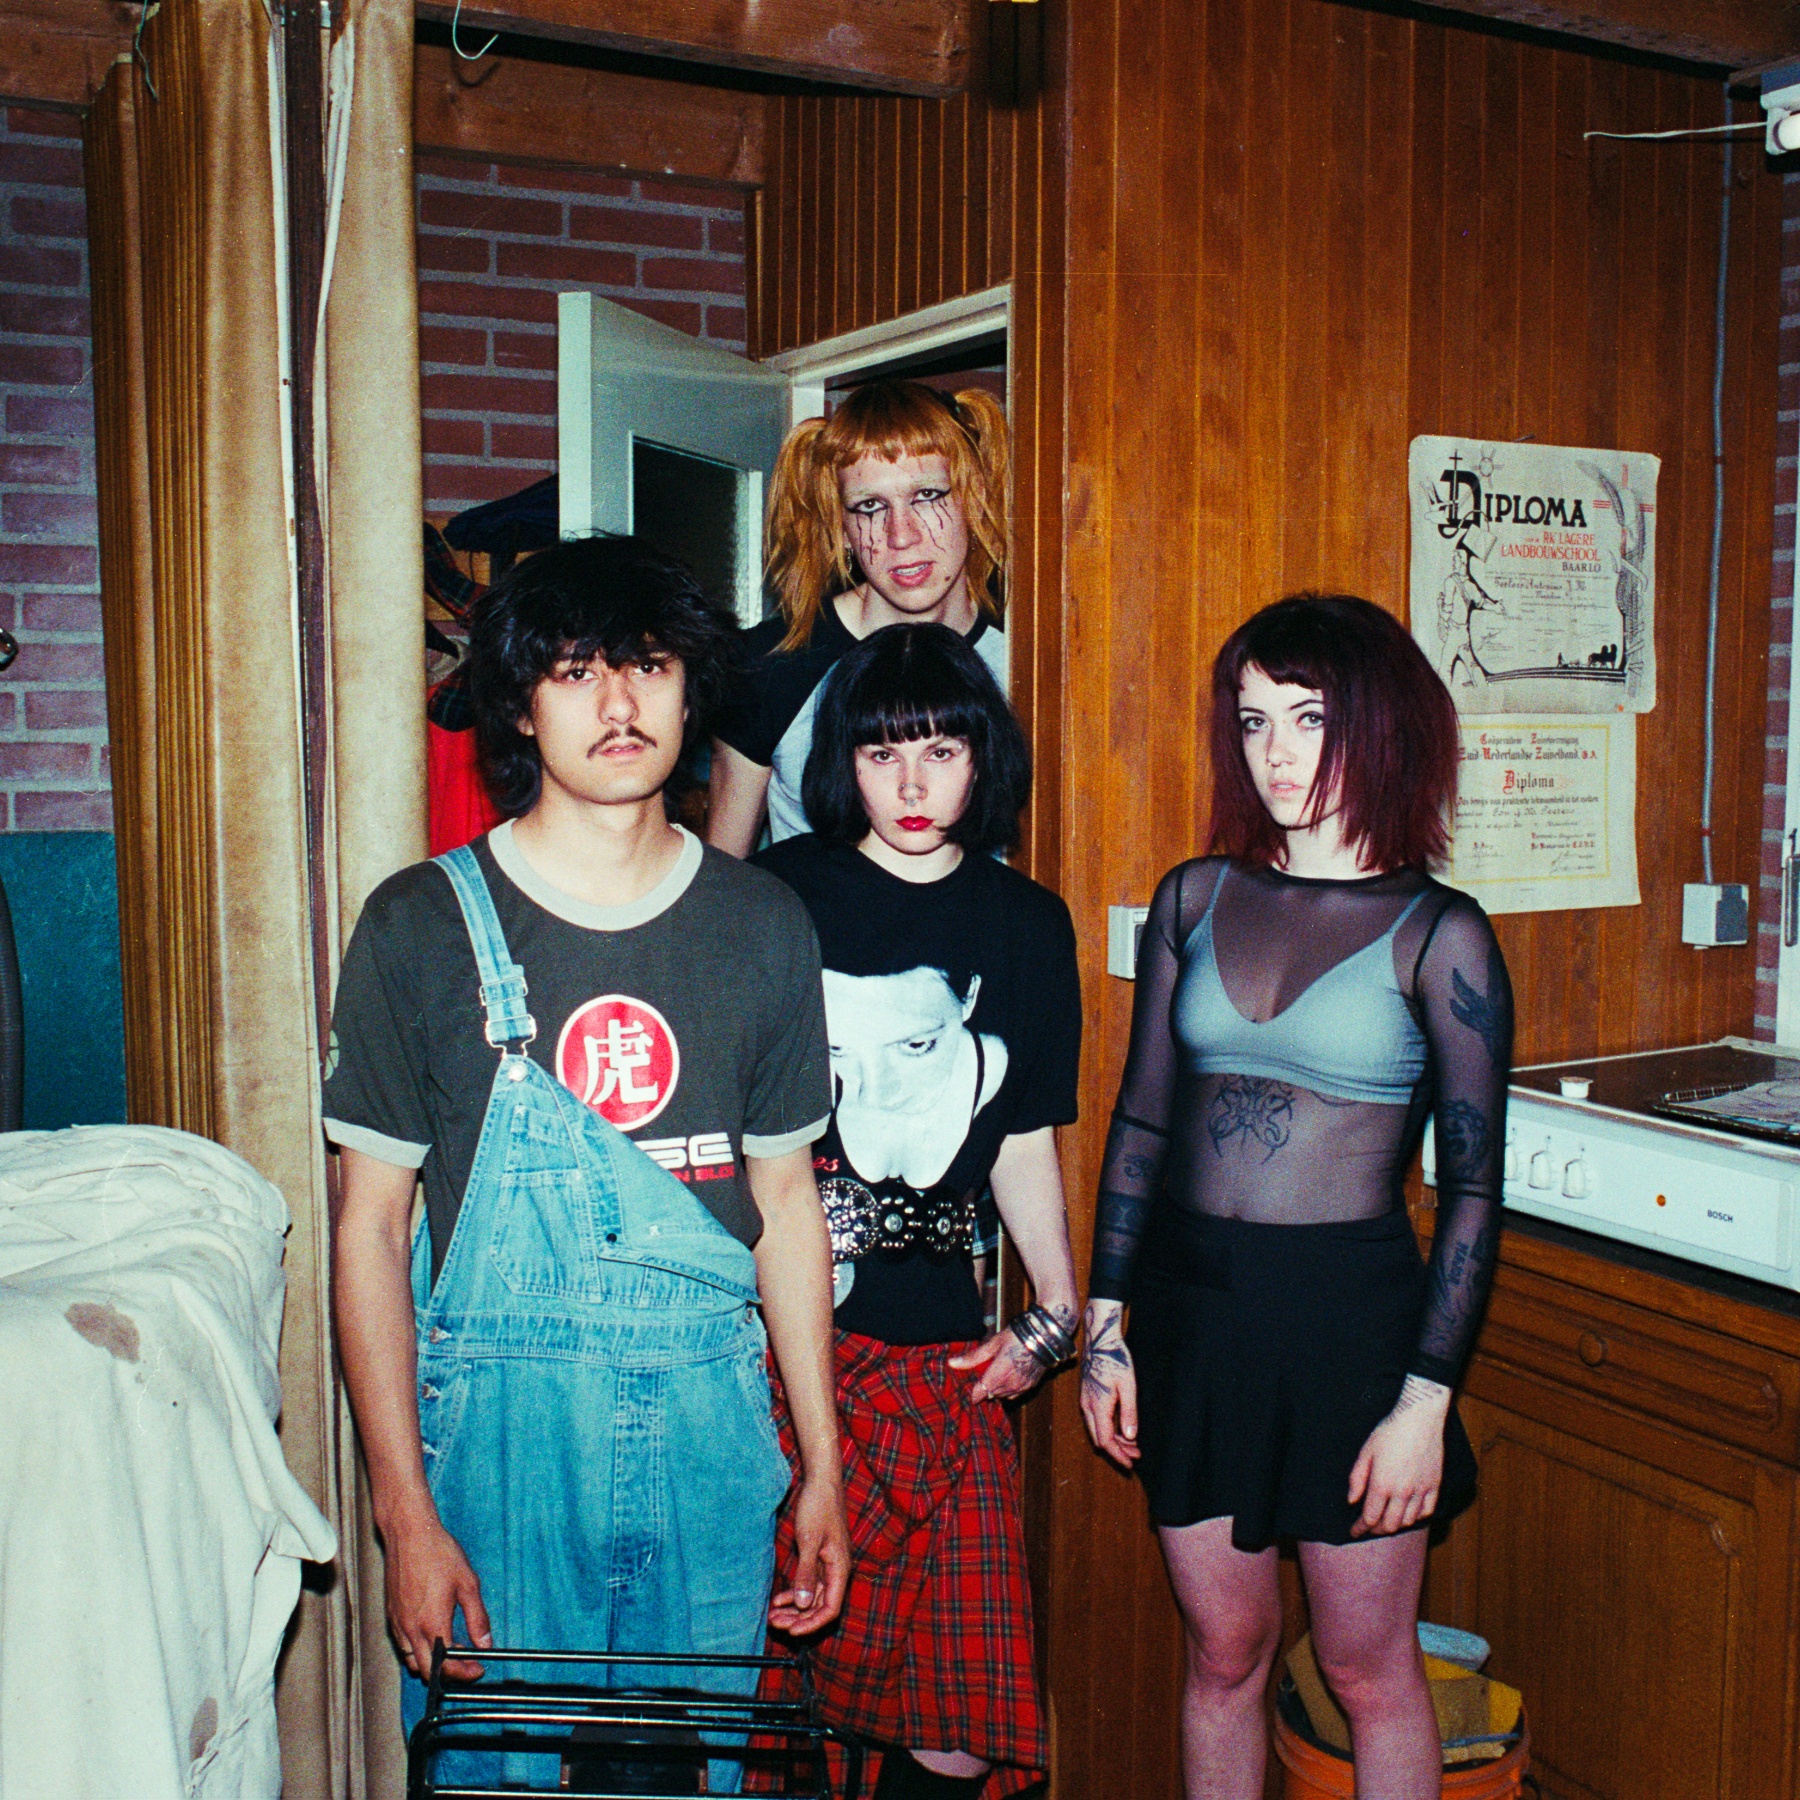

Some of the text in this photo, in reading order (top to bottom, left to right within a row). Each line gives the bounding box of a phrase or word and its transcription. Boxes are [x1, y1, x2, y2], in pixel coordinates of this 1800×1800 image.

[1438, 469, 1588, 539] DIPLOMA
[1501, 543, 1601, 562] LANDBOUWSCHOOL
[1562, 561, 1602, 573] BAARLO
[1503, 769, 1555, 795] Diploma
[582, 1018, 660, 1106] 虎
[1706, 1209, 1734, 1223] BOSCH
